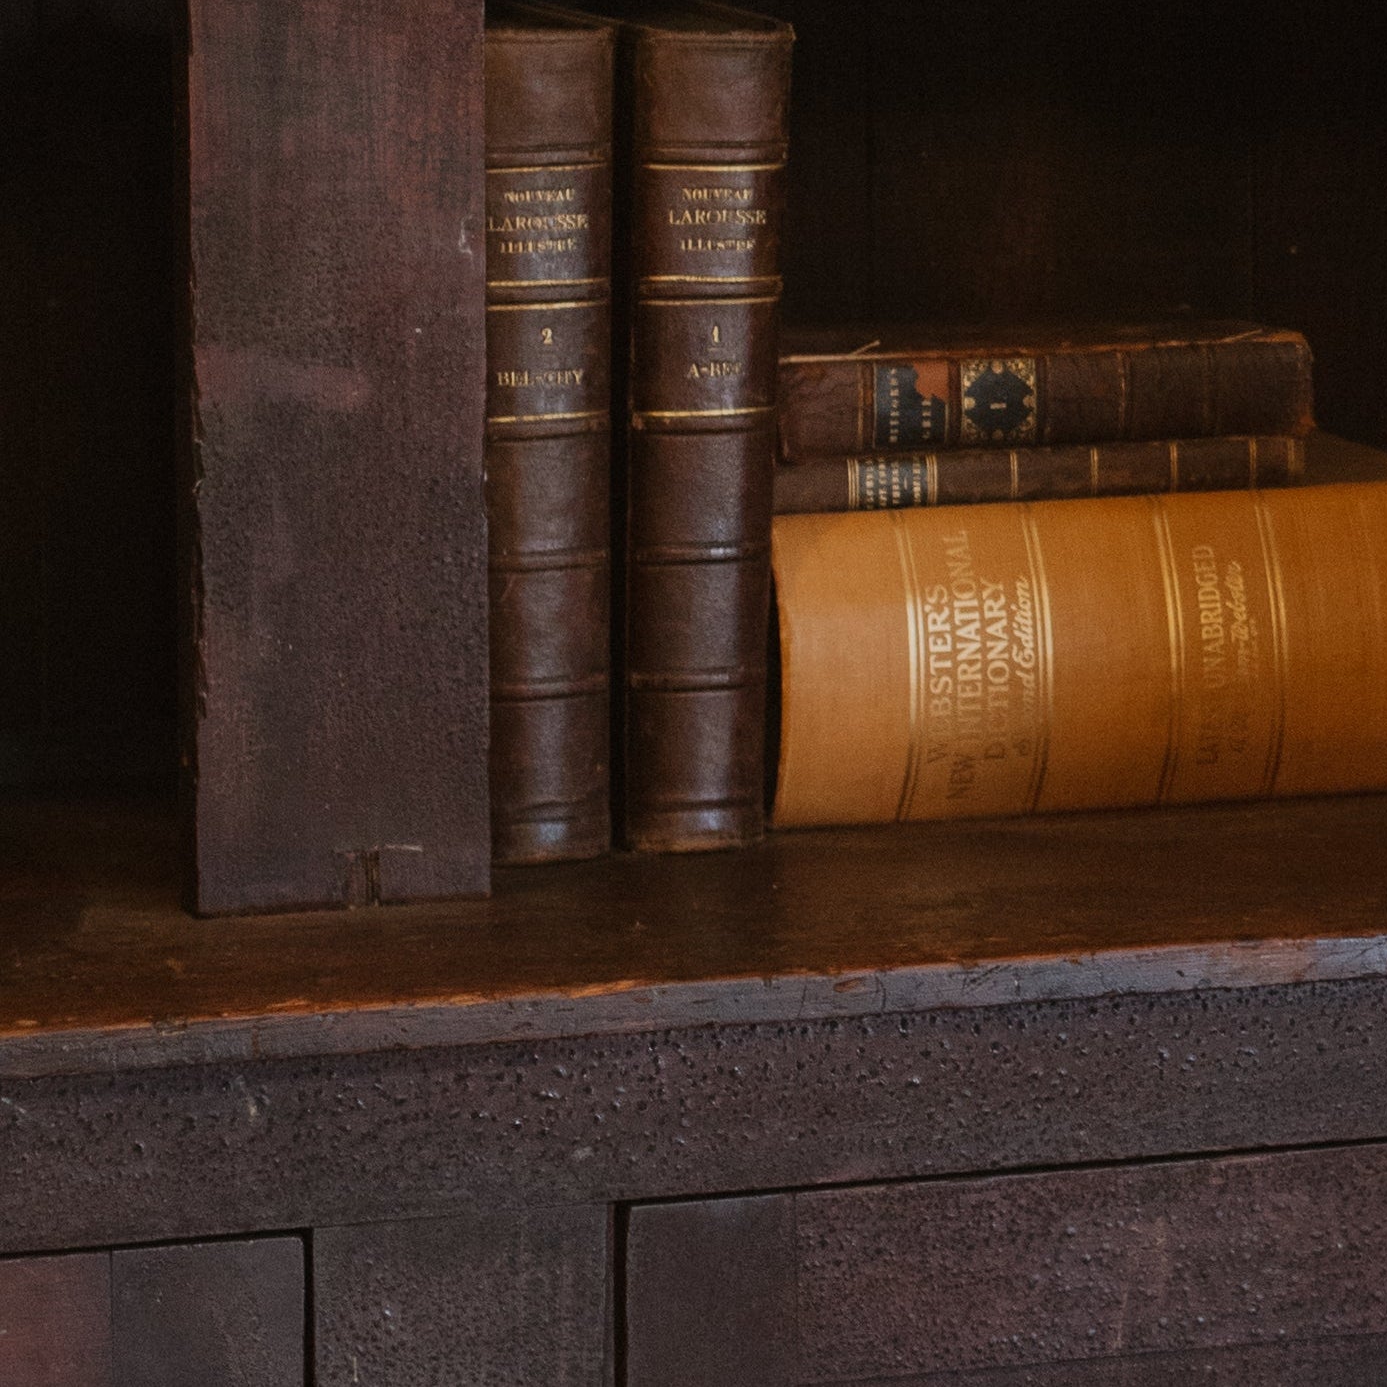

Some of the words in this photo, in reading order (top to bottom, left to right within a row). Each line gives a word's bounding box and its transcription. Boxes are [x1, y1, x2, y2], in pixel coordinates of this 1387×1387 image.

[503, 187, 576, 203] NOUVEAU
[682, 187, 753, 202] NOUVEAU
[487, 214, 590, 232] LAROUSSE
[668, 209, 768, 226] LAROUSSE
[541, 326, 553, 346] 2
[711, 325, 721, 344] 1
[1012, 575, 1037, 669] Edition
[1193, 544, 1225, 690] UNABRIDGED
[943, 529, 984, 744] INTERNATIONAL
[924, 583, 954, 765] WEBSTER'S
[980, 577, 1012, 761] DICTIONARY
[945, 752, 977, 801] NEW
